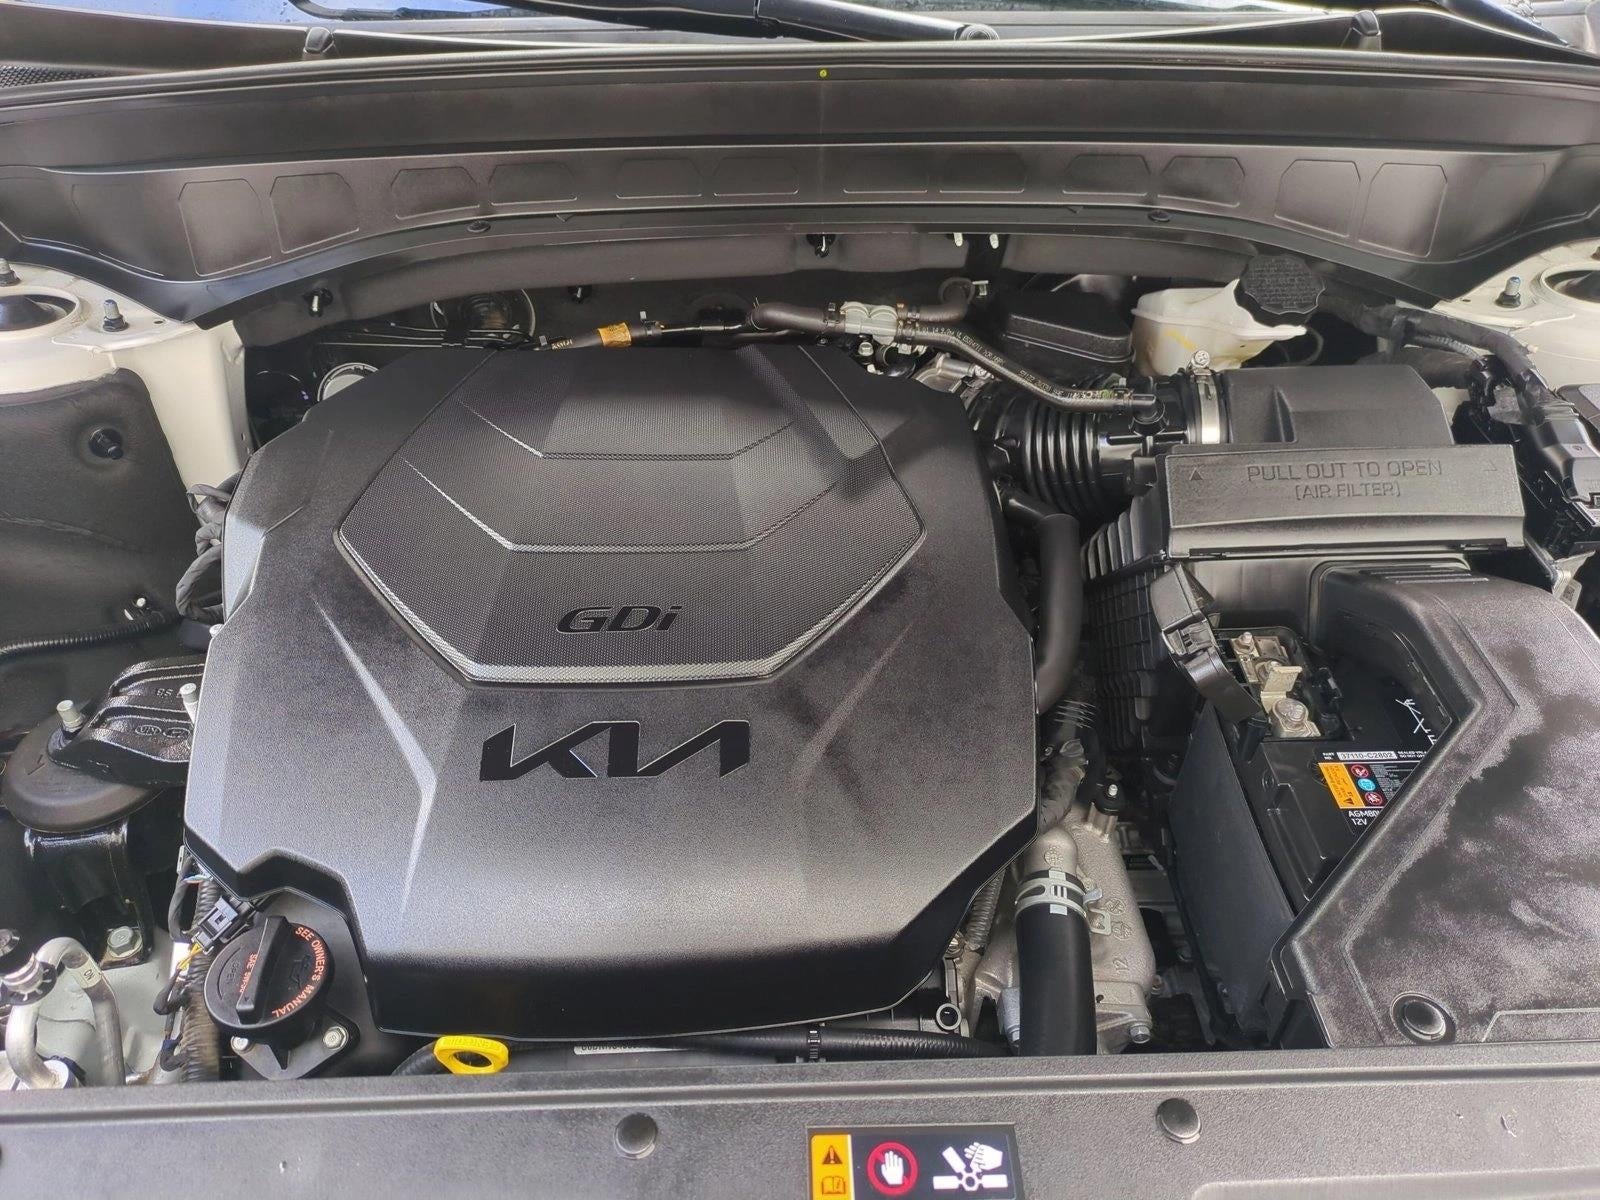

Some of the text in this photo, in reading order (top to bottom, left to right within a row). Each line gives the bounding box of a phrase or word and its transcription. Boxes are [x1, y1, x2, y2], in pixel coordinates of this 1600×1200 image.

[1248, 460, 1441, 482] PULL OUT TO OPEN
[556, 606, 682, 634] GDi
[295, 926, 315, 941] SEE
[311, 939, 326, 982] OWNER'S
[271, 984, 315, 1018] MANUAL
